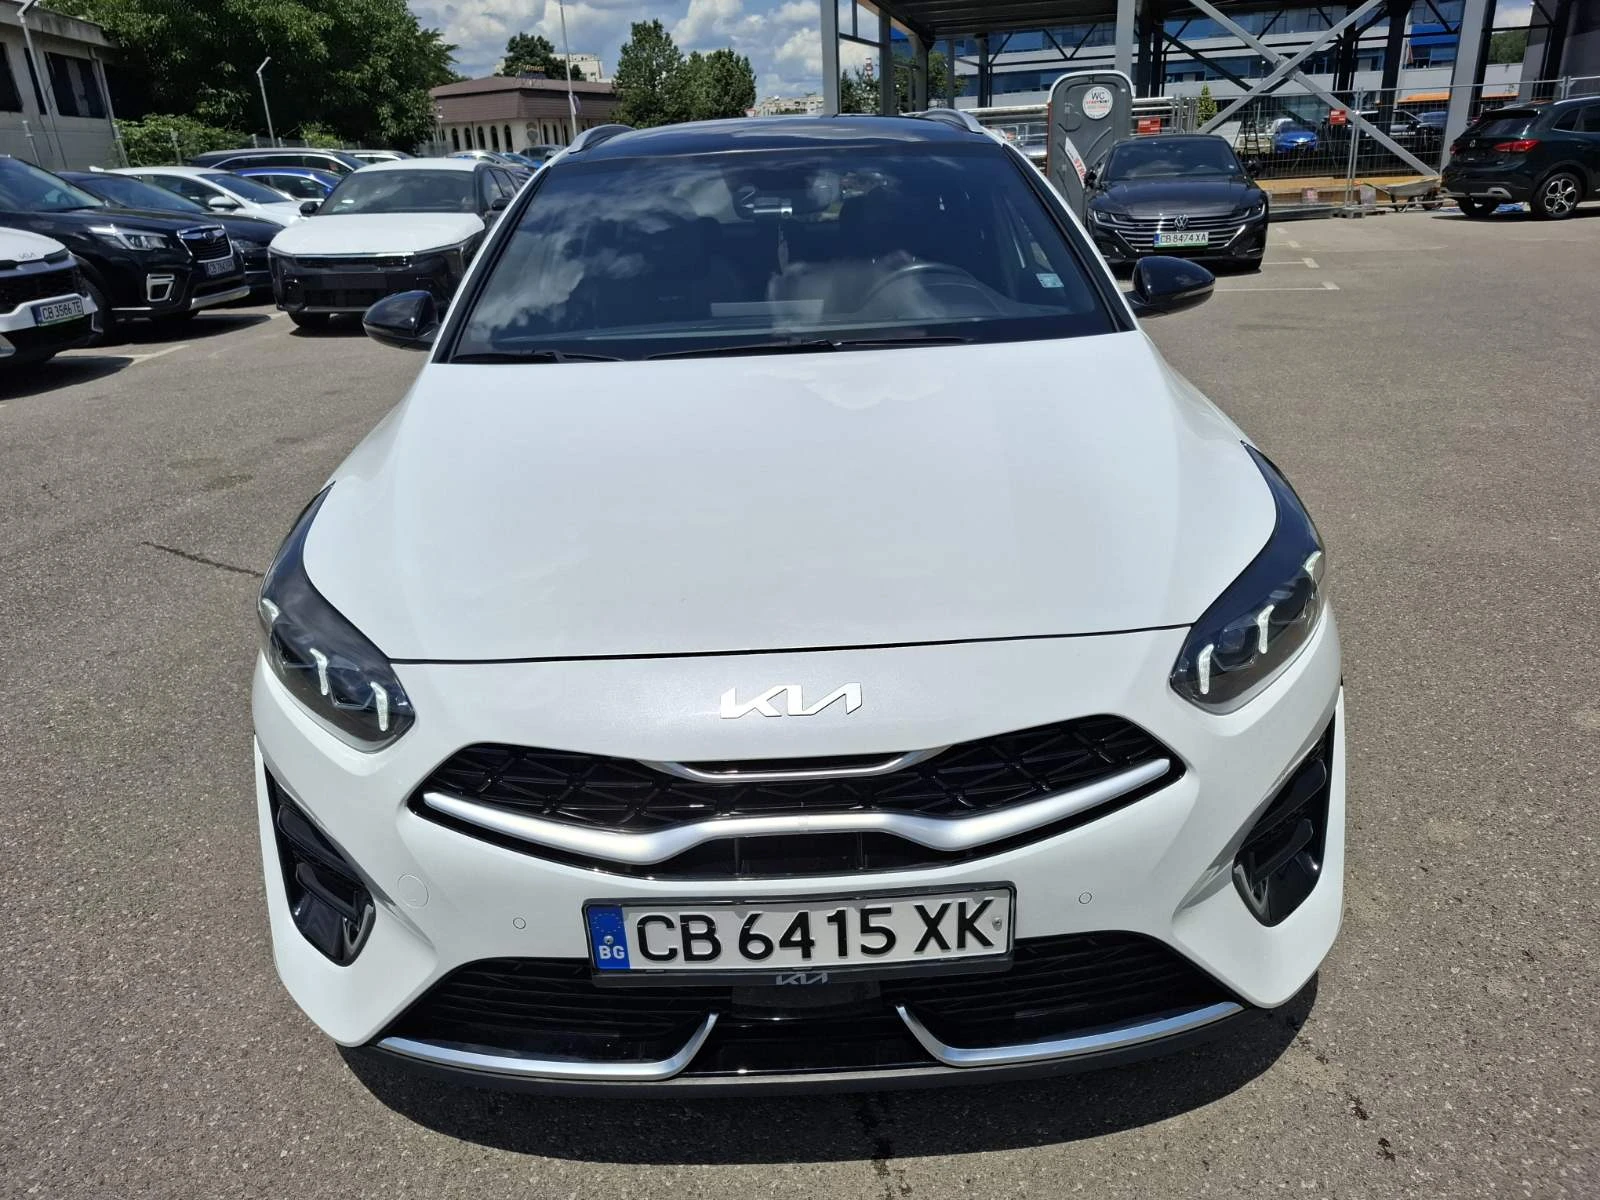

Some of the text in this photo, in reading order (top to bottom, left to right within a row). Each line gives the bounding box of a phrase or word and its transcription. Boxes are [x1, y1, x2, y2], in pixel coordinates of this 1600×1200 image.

[1091, 92, 1105, 100] WC
[42, 307, 54, 320] CB
[71, 301, 82, 313] TE
[719, 682, 862, 719] KIA
[636, 898, 996, 962] CB 6415 XK
[598, 945, 626, 961] BG
[775, 972, 829, 986] KIA
